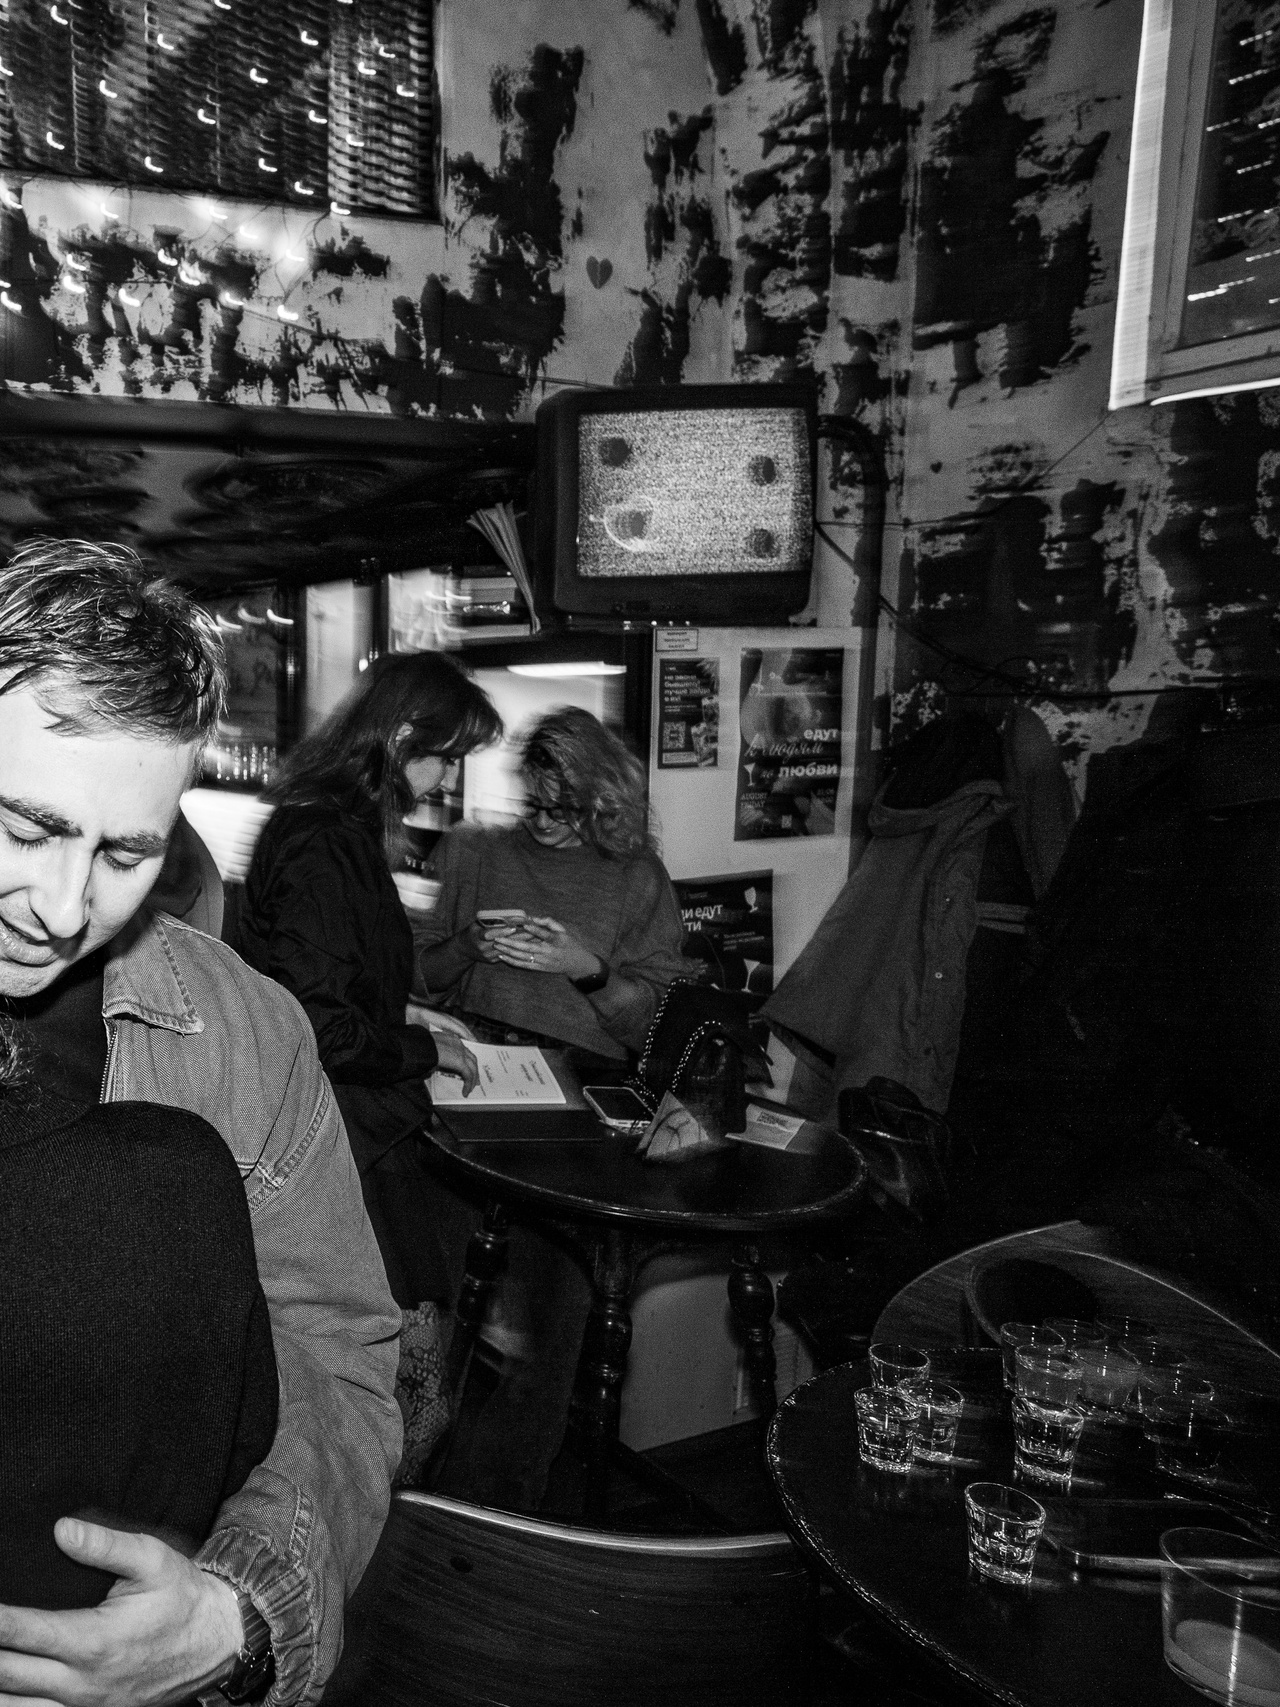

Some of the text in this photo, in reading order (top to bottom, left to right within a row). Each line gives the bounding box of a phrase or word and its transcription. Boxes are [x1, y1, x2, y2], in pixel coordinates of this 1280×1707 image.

[804, 728, 839, 741] едут
[778, 762, 838, 778] любви
[695, 904, 723, 920] едут
